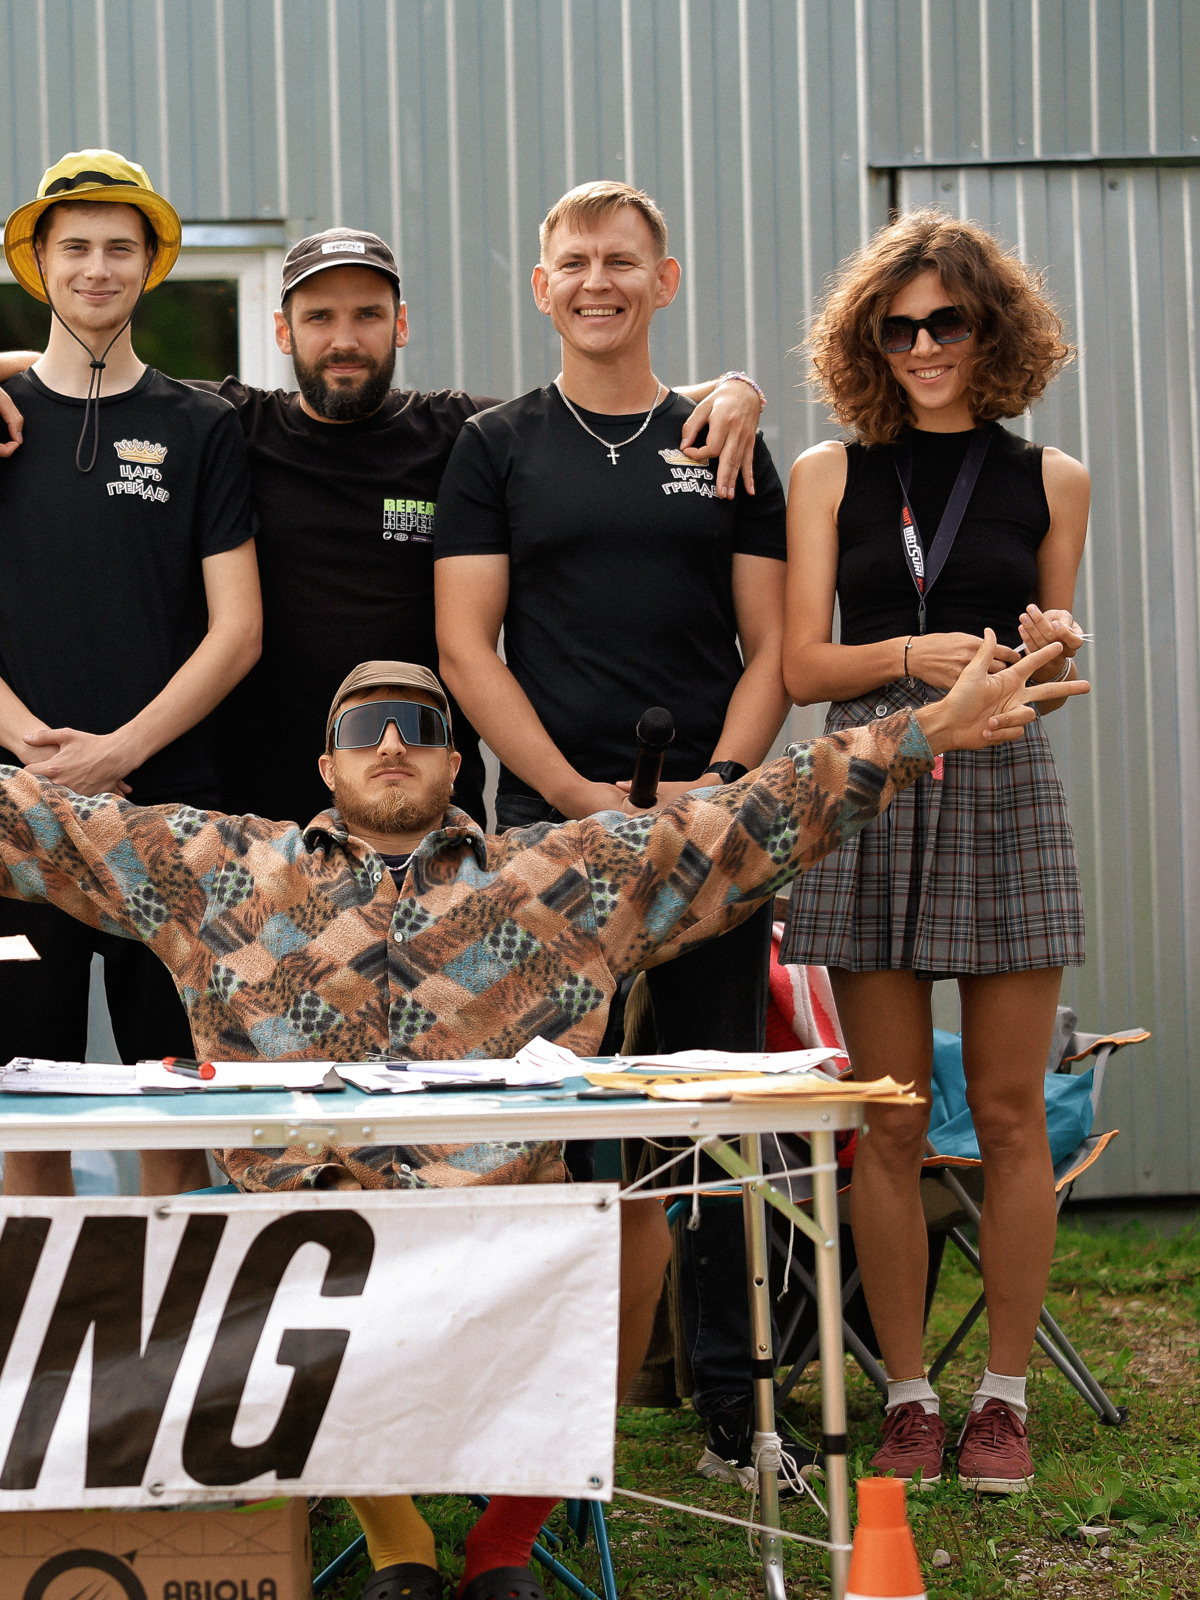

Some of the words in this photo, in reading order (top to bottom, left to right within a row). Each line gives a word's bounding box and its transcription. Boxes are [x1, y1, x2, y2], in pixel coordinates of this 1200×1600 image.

[119, 464, 163, 482] ЦАРЬ
[670, 467, 714, 481] ЦАРЬ
[106, 478, 171, 503] ГРЕЙДЕР
[661, 478, 722, 499] ГРЕЙДЕ
[383, 498, 437, 516] REPEA
[903, 525, 925, 578] MATSURI
[164, 1578, 277, 1600] ABIOLA
